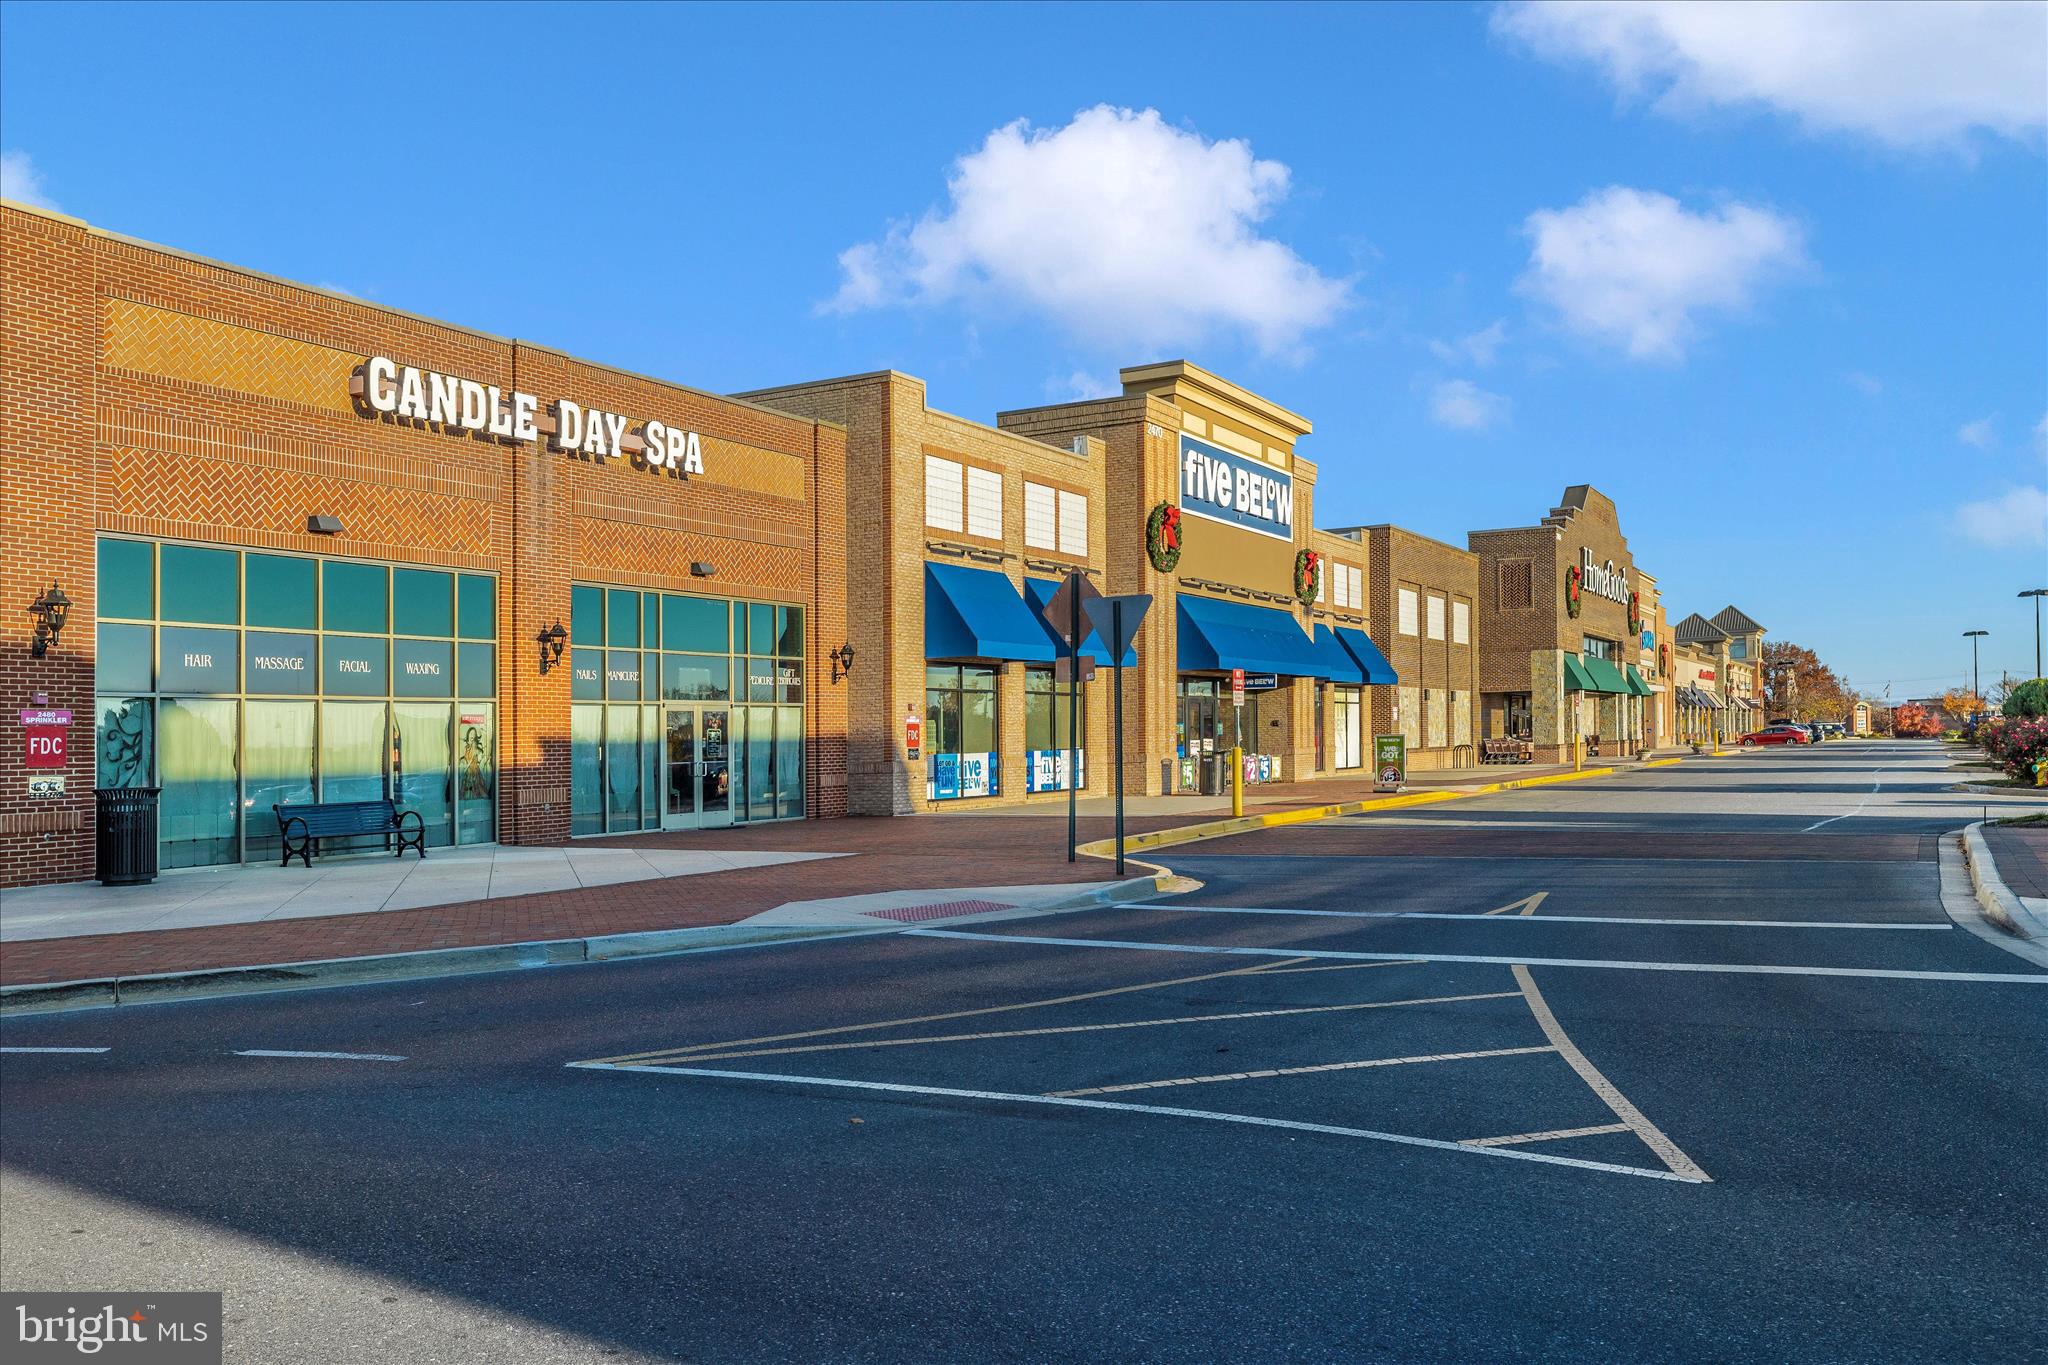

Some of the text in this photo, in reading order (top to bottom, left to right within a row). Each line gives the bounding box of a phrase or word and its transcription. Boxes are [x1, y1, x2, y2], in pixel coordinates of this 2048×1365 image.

[369, 356, 704, 474] CANDLE DAY SPA
[1148, 422, 1162, 438] 2470
[1185, 449, 1292, 526] five BELOW
[184, 654, 212, 667] HAIR
[255, 656, 304, 670] MASSAGE
[339, 660, 371, 673] FACIAL
[405, 662, 440, 675] WAXING
[576, 669, 597, 681] NAILS
[783, 668, 796, 678] GIFT
[607, 670, 639, 682] MANICURE
[908, 730, 919, 741] FDC
[30, 737, 63, 755] FDC
[1381, 751, 1399, 759] GOT
[1183, 765, 1193, 785] $5
[1260, 760, 1269, 779] $5
